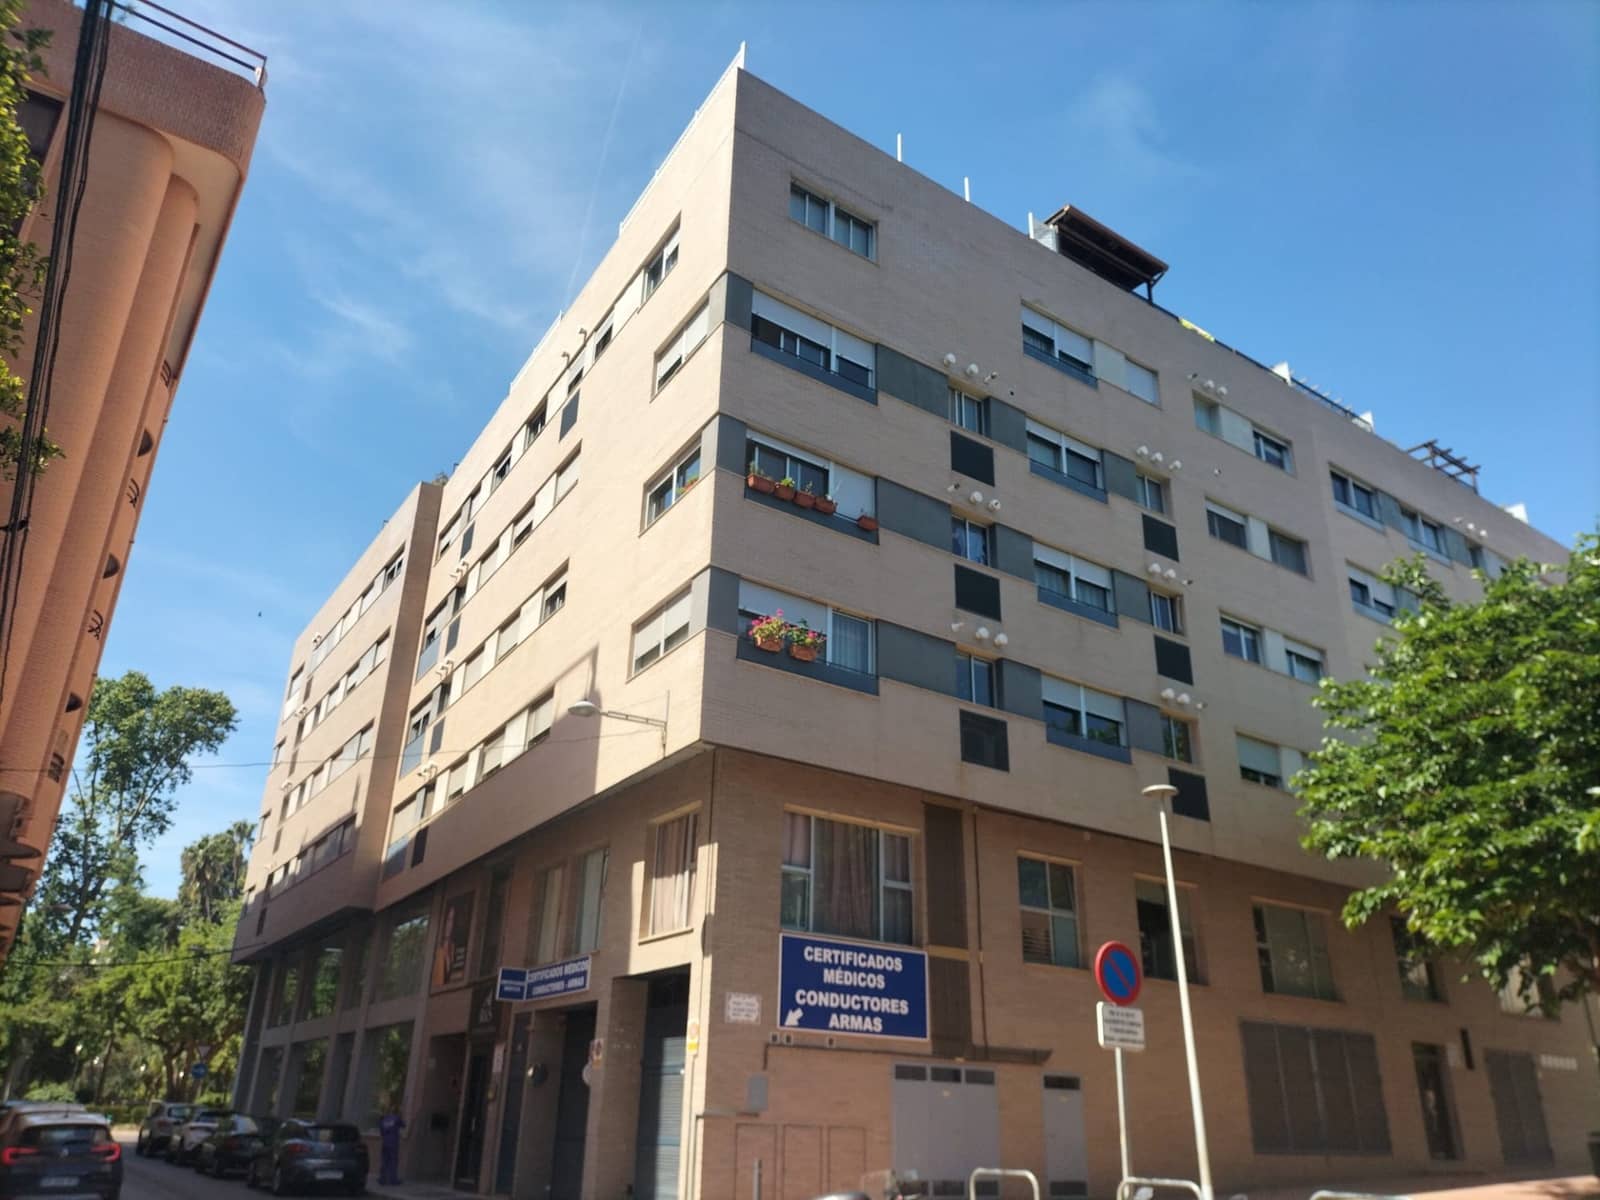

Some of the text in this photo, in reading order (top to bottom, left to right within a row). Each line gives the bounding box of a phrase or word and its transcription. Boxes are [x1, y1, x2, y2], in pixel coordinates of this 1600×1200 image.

[804, 946, 903, 972] CERTIFICADOS
[823, 967, 885, 989] MÉDICOS
[795, 989, 909, 1015] CONDUCTORES
[828, 1013, 883, 1033] ARMAS
